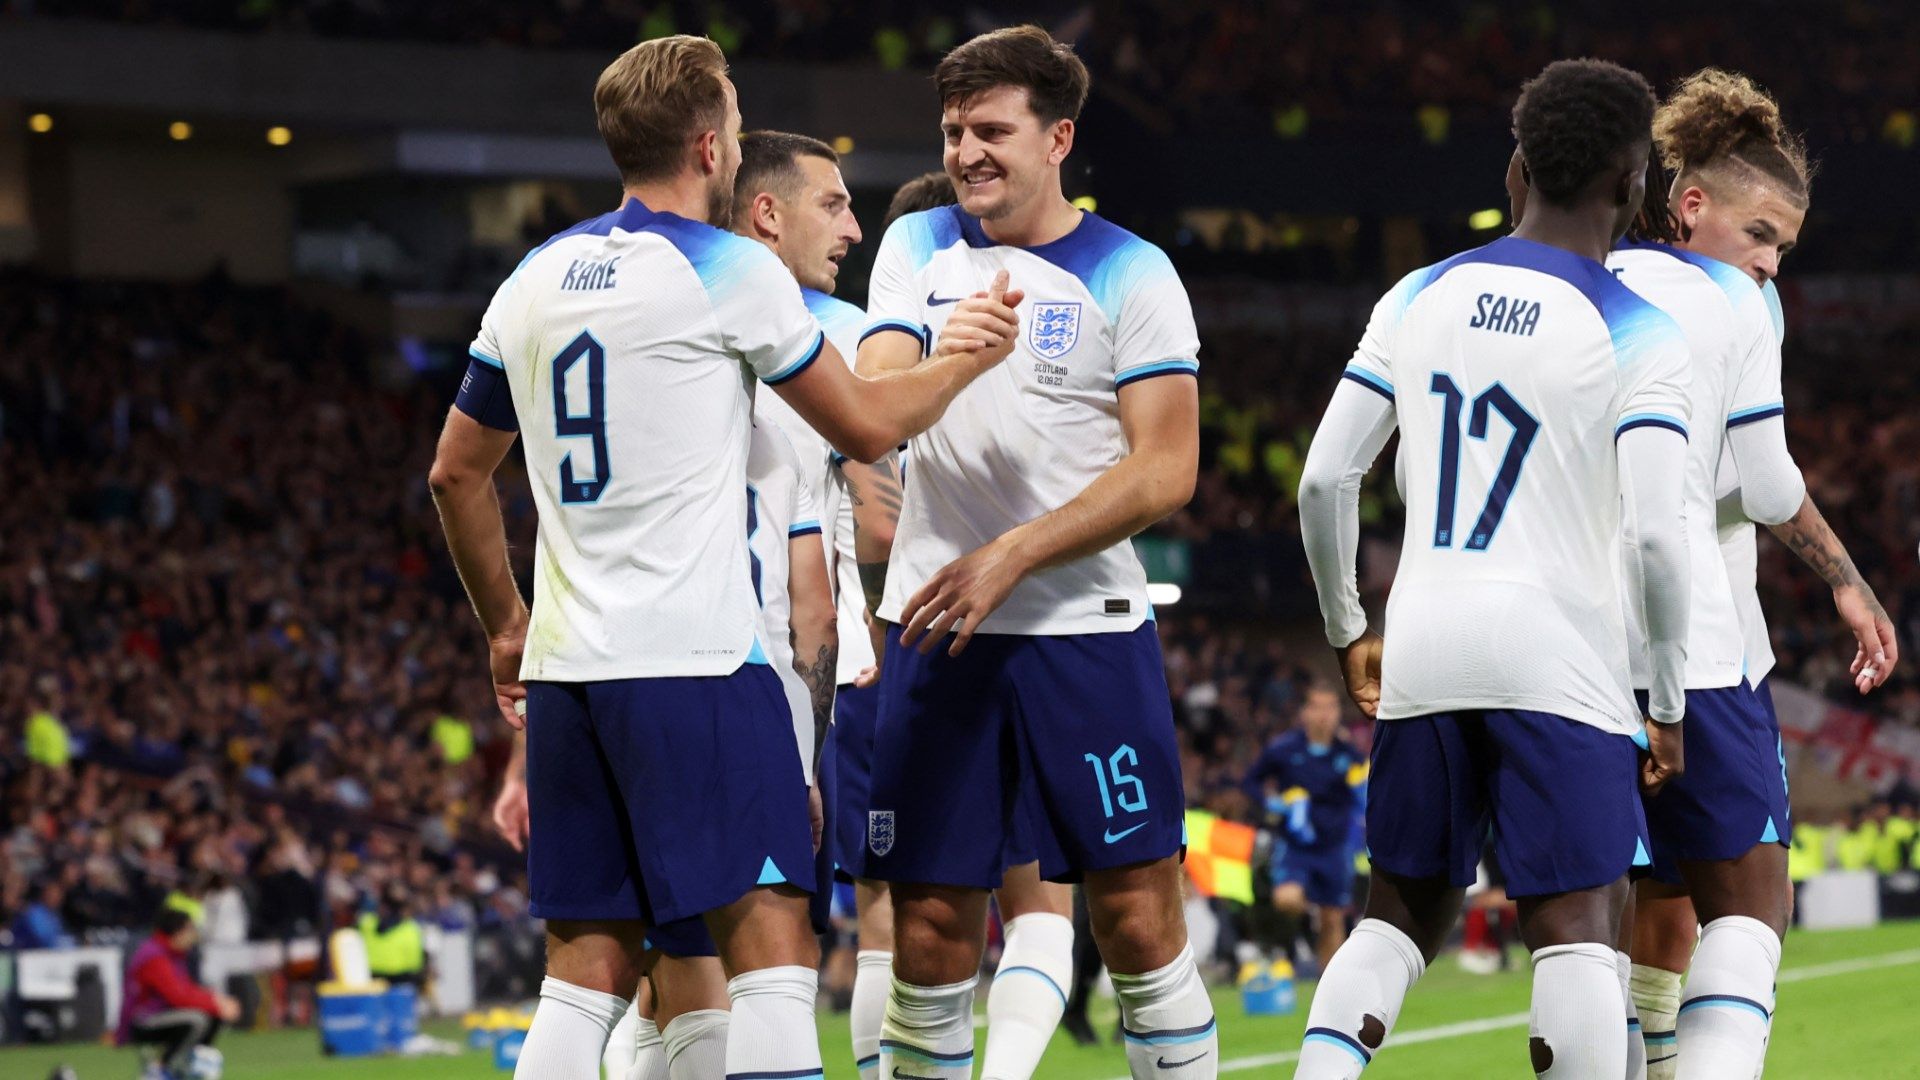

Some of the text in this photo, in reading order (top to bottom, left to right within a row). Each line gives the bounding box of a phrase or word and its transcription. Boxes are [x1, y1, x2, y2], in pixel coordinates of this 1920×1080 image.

[561, 255, 621, 291] KANE
[1469, 292, 1541, 336] SAKA
[1034, 363, 1068, 376] SCOTLAND
[550, 327, 612, 507] 9
[1428, 369, 1542, 553] 17
[1084, 743, 1148, 818] 15
